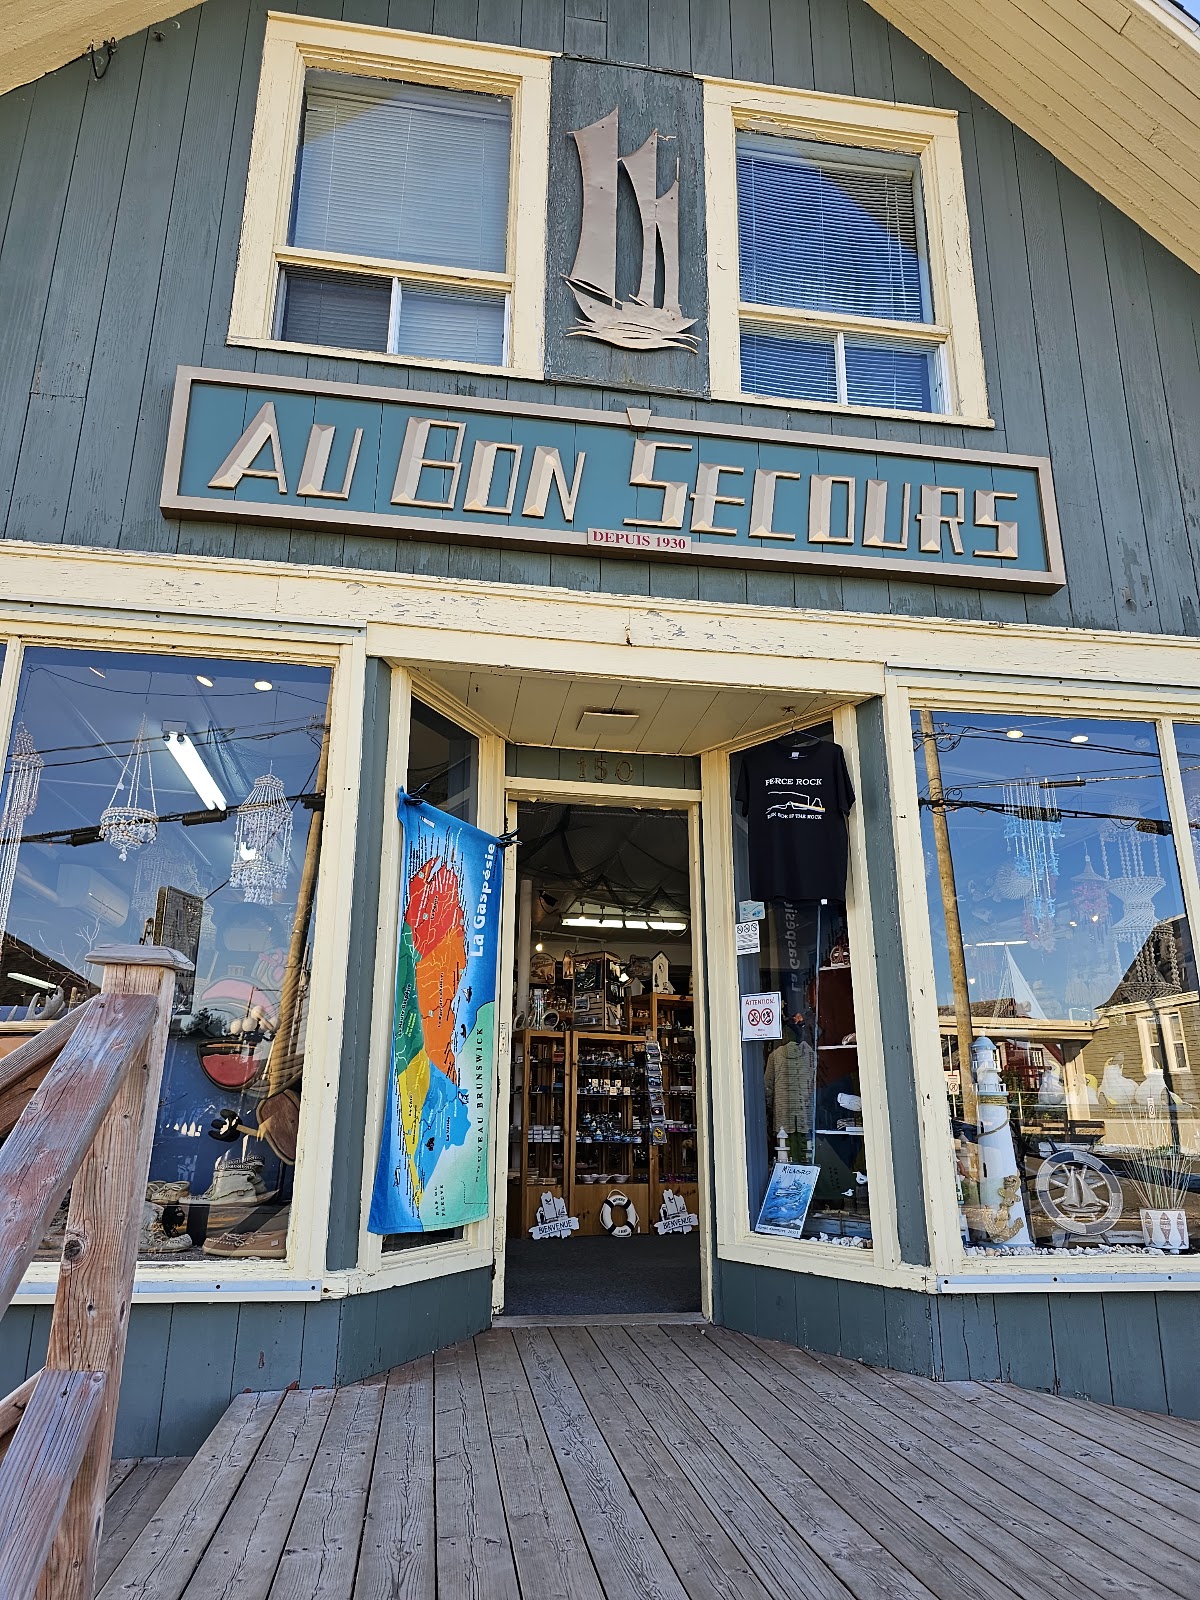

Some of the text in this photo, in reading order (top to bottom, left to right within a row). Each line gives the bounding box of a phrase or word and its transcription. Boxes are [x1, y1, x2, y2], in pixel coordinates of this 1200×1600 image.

[207, 401, 1018, 560] AU BON SECOURS
[593, 530, 686, 549] DEPUIS 1930
[577, 757, 634, 782] 150
[795, 778, 823, 786] ROCK
[469, 843, 496, 957] La Gaspésie
[475, 1117, 484, 1183] UVEAU
[539, 1219, 572, 1235] BIENVENUE
